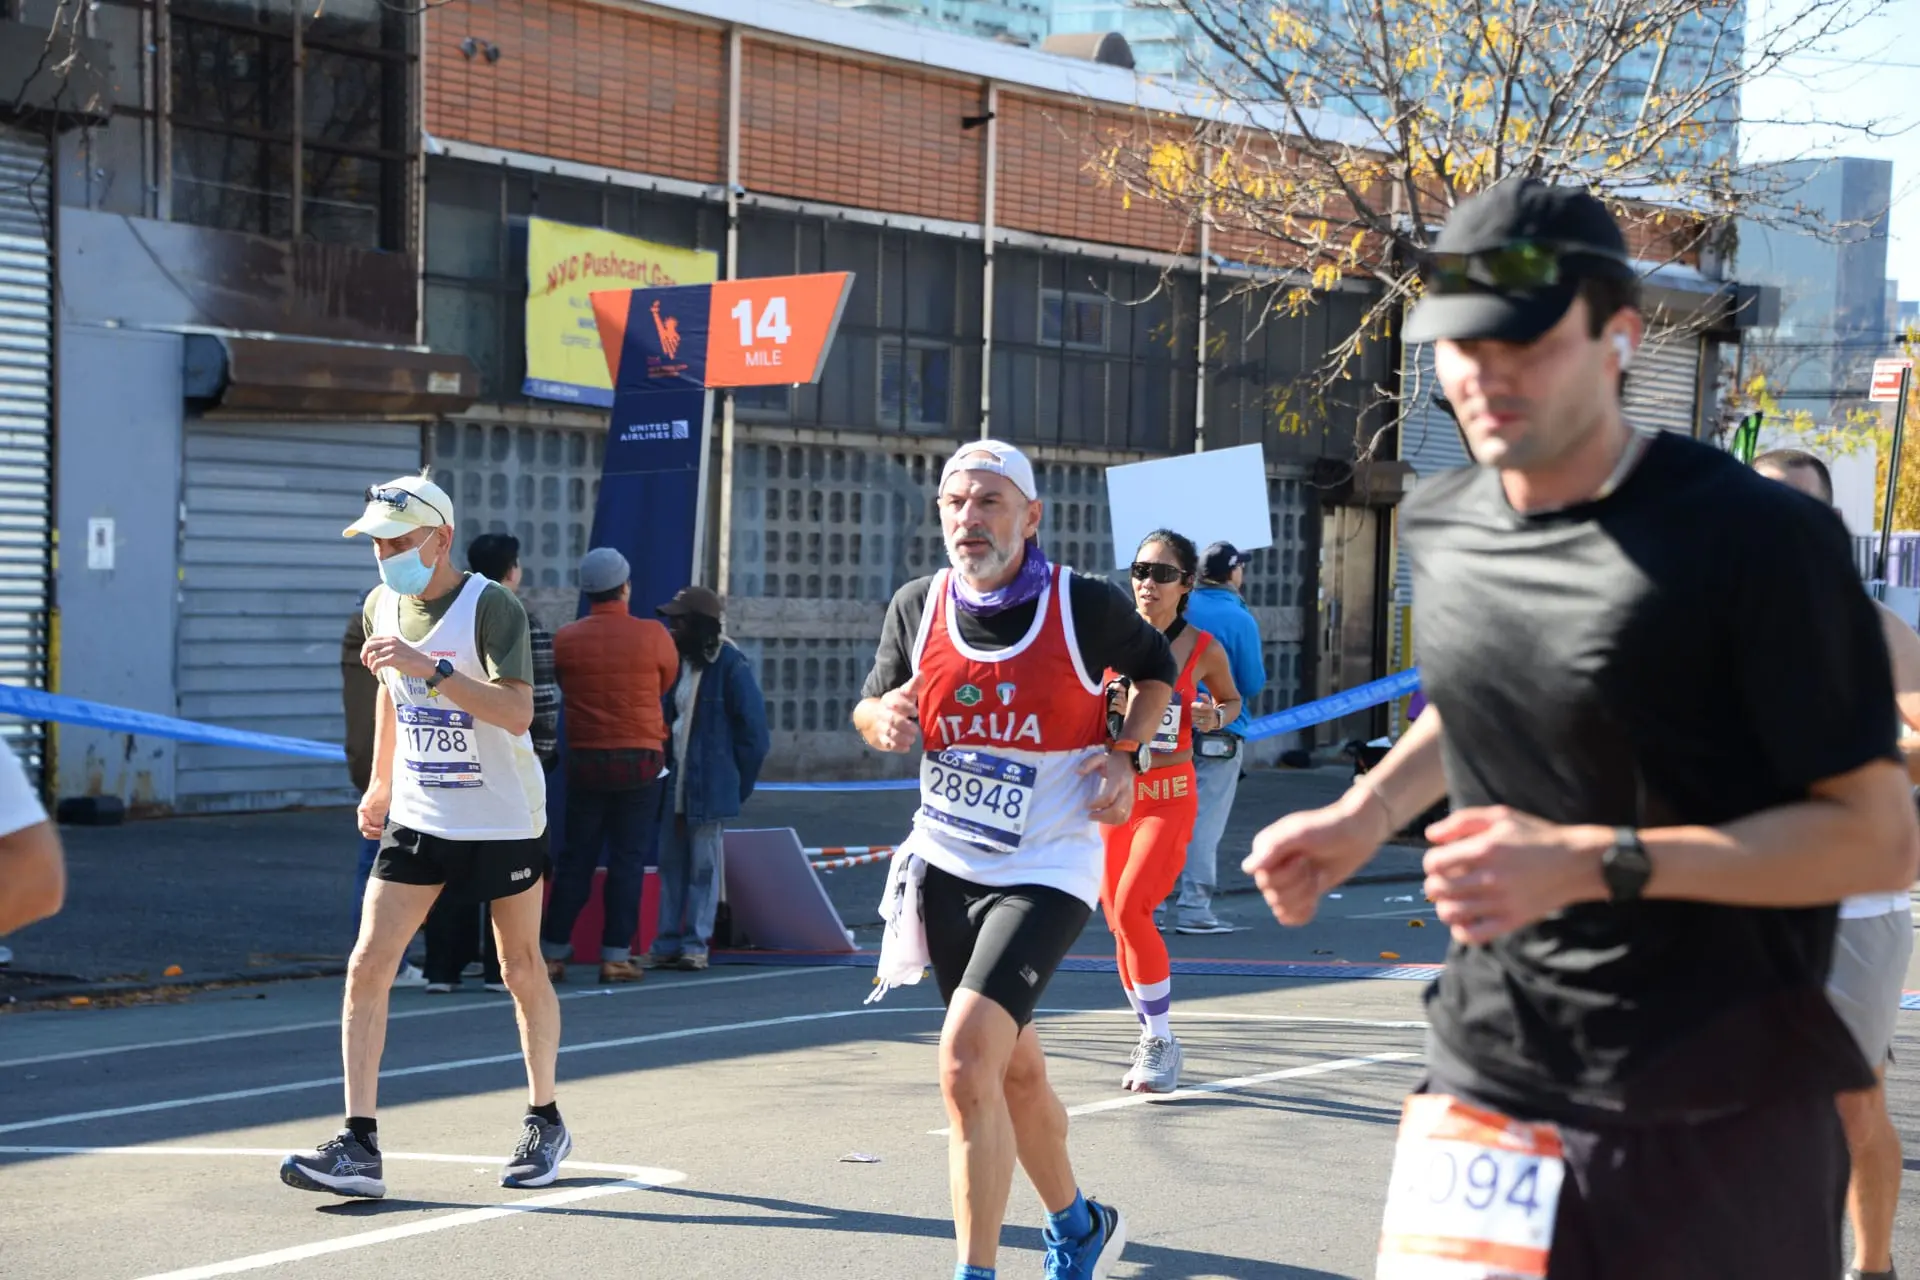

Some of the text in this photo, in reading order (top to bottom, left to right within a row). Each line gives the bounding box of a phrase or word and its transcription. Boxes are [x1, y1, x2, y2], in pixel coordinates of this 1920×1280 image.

[545, 255, 579, 296] NYC
[582, 249, 648, 285] Pushcart
[731, 296, 792, 347] 14
[745, 349, 783, 368] MILE
[620, 431, 670, 441] AIRLINES
[628, 422, 670, 433] UNITED
[405, 727, 468, 753] 11788
[936, 712, 1042, 745] ITALIA
[930, 766, 1024, 819] 28948
[1137, 774, 1189, 801] NIE
